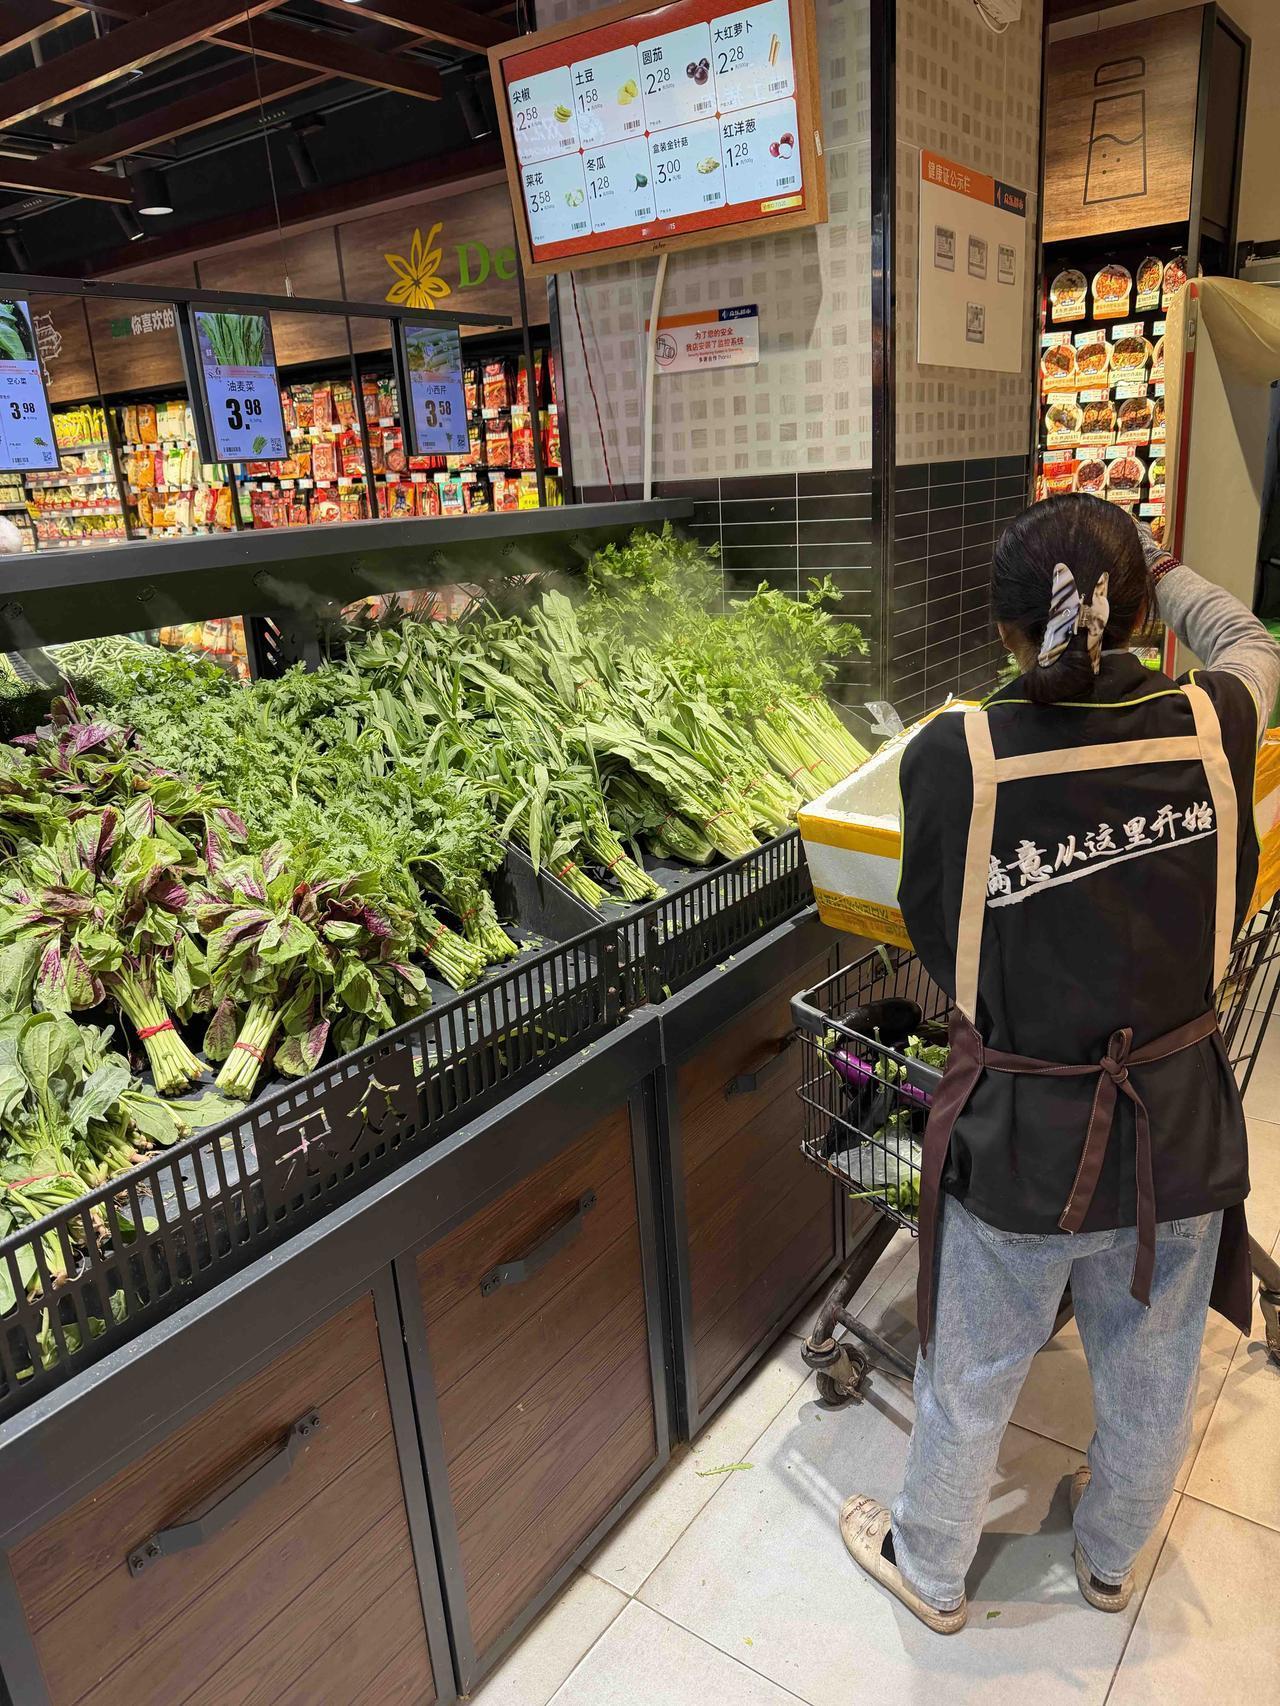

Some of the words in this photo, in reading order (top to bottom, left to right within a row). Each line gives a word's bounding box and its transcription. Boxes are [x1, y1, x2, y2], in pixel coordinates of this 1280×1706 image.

[714, 20, 753, 44] 大红萝卜
[642, 46, 663, 65] 圆茄
[575, 68, 595, 86] 土豆
[512, 88, 532, 105] 尖椒
[723, 118, 757, 139] 红洋葱
[652, 136, 689, 154] 盒装金针菇
[586, 155, 607, 172] 冬瓜
[525, 172, 544, 188] 菜花
[927, 160, 971, 193] 健康证公示栏
[131, 308, 175, 336] 你喜欢的
[695, 327, 733, 340] 为了您的安全
[6, 377, 27, 385] 空心菜
[227, 380, 256, 393] 油麦菜
[426, 385, 448, 396] 小西芹
[10, 402, 36, 420] 3.98
[225, 398, 262, 431] 3.98
[425, 399, 452, 428] 3.58
[986, 801, 1214, 897] 满意从这里开始
